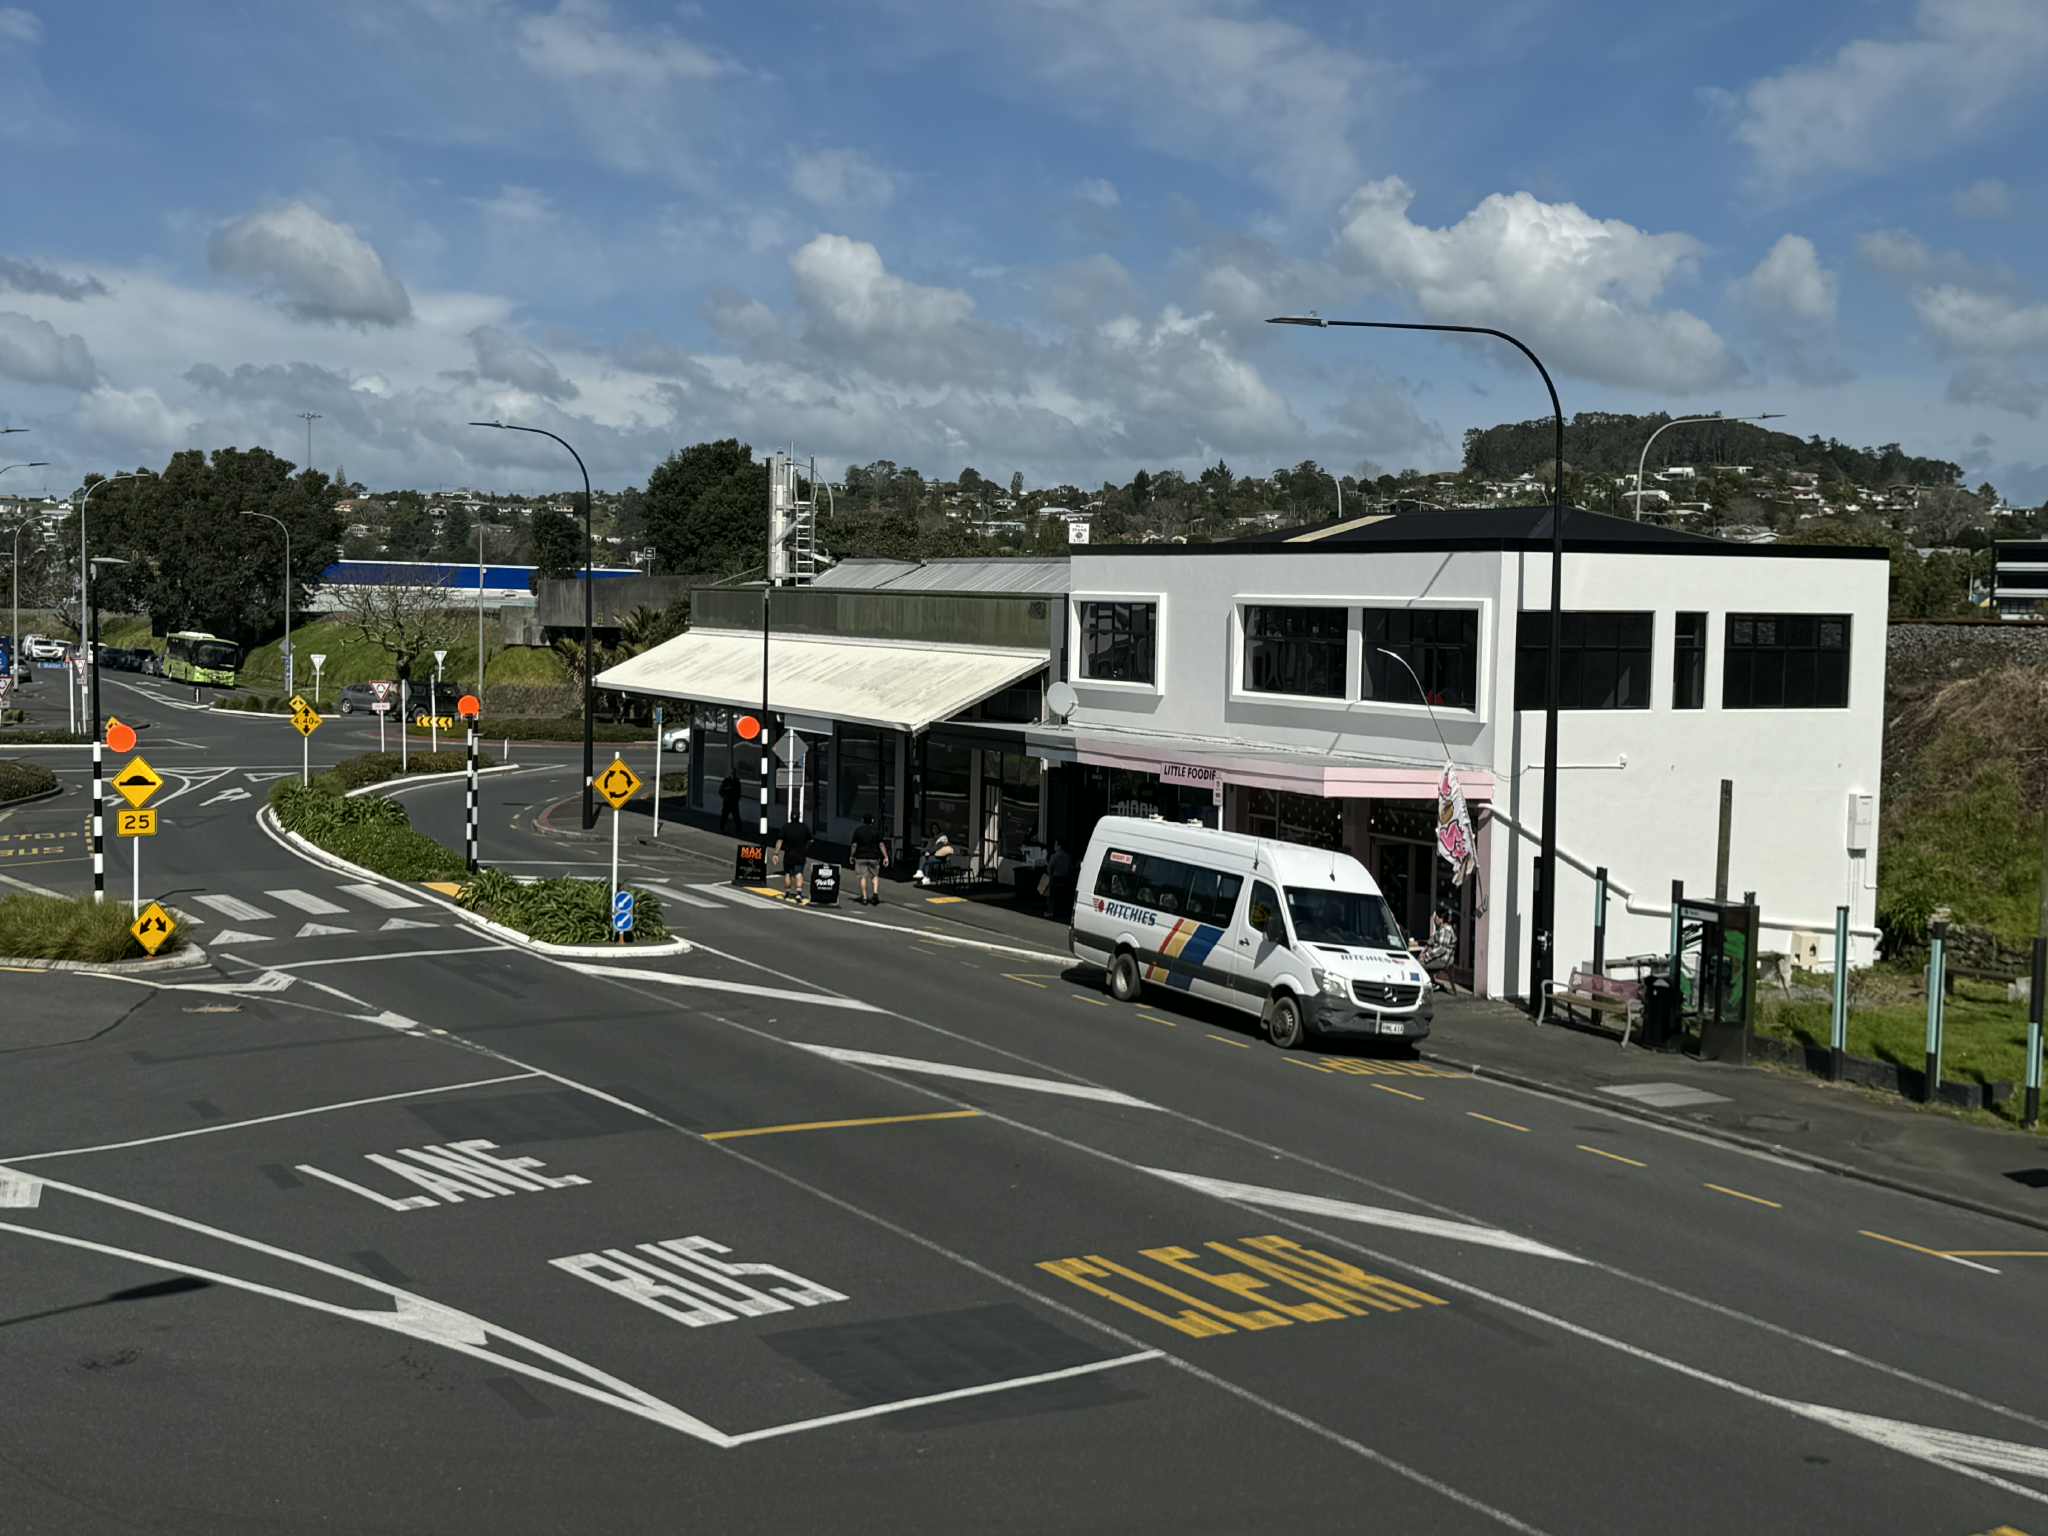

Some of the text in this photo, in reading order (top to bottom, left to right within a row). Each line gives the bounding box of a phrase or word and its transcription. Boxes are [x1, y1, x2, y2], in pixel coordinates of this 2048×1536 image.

[1163, 764, 1187, 778] LITTLE
[124, 815, 150, 830] 25
[1105, 901, 1158, 927] RITCHIES
[295, 1139, 592, 1212] LANE
[548, 1235, 850, 1328] BUS
[1034, 1234, 1451, 1339] CLEAR
